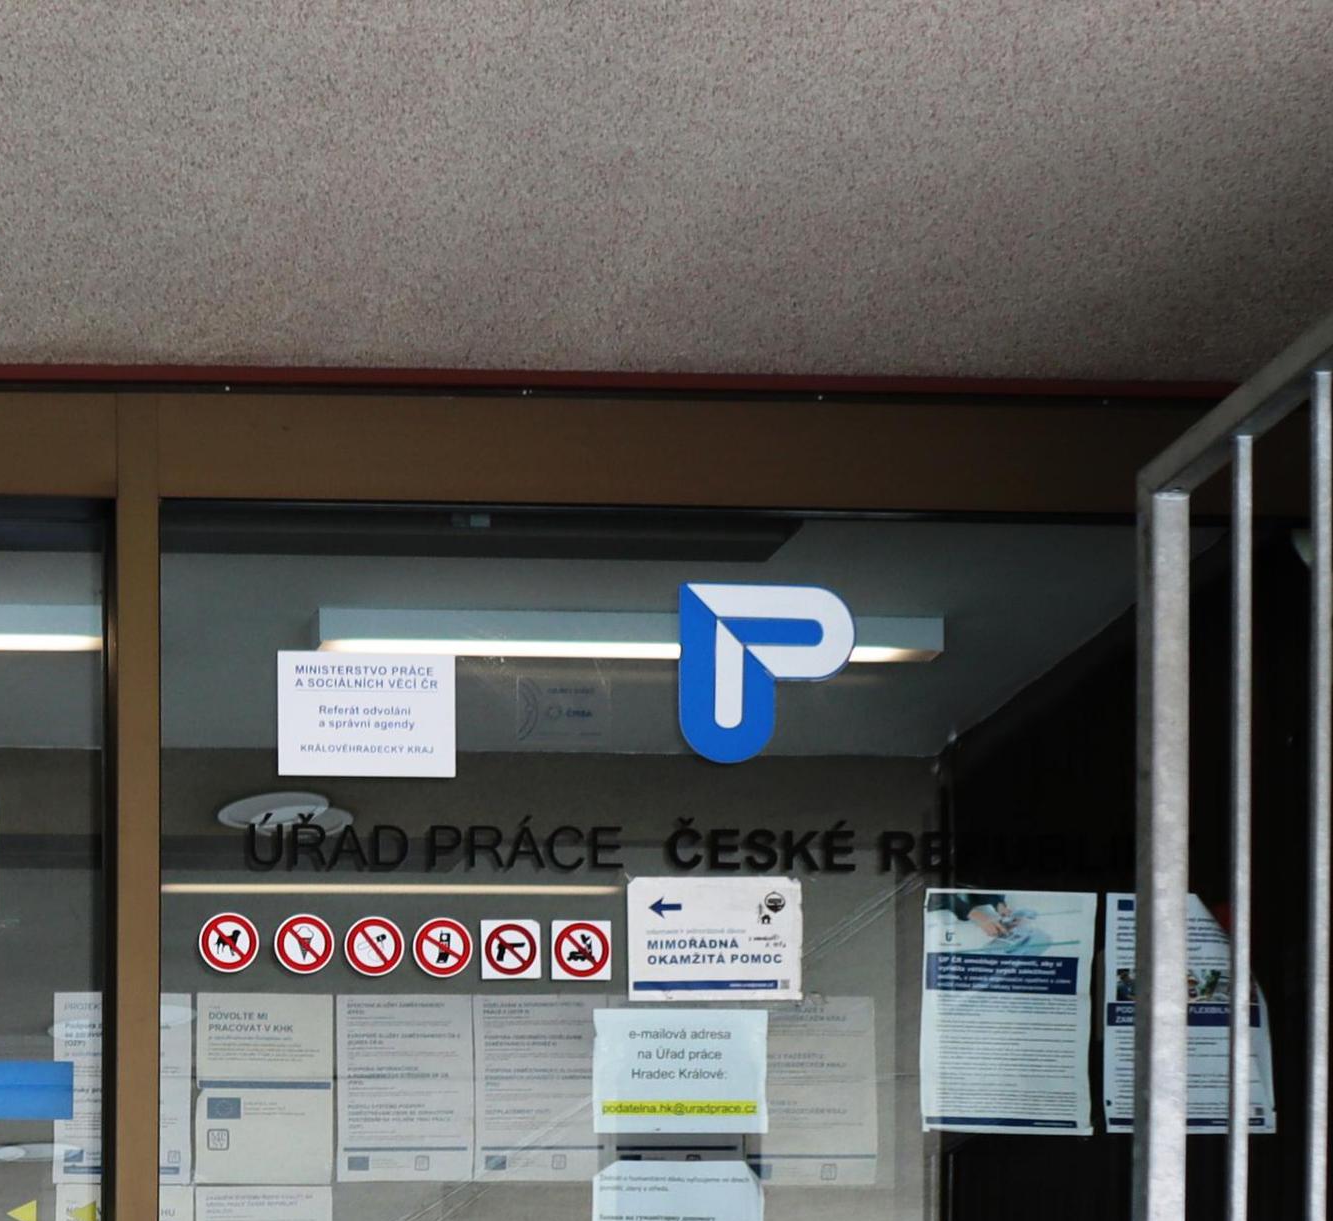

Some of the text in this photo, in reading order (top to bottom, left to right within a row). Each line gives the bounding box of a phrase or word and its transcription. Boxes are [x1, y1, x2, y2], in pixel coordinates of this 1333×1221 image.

[295, 665, 434, 676] MINISTERSTVO PRÁCE
[295, 677, 437, 689] A SOCIÁLNÍCH VĚCÍ ČR
[319, 705, 411, 716] Referát odvolání
[329, 718, 370, 729] správní
[374, 720, 414, 731] agendy
[300, 743, 434, 754] KRÁLOVÉHRADECKÝ KRAJ
[247, 812, 409, 868] ÚŘAD
[428, 814, 624, 870] PRÁCE
[665, 816, 856, 873] ČESKÉ
[647, 938, 739, 949] MIMOŘÁDNÁ
[647, 952, 782, 965] OKAMŽITÁ POMOC
[208, 1012, 253, 1020] DOVOLTE
[208, 1024, 261, 1032] PRACOVAT
[629, 1029, 731, 1039] e-mailová adresa
[638, 1047, 722, 1061] na Úřad práce
[632, 1069, 675, 1079] Hradec
